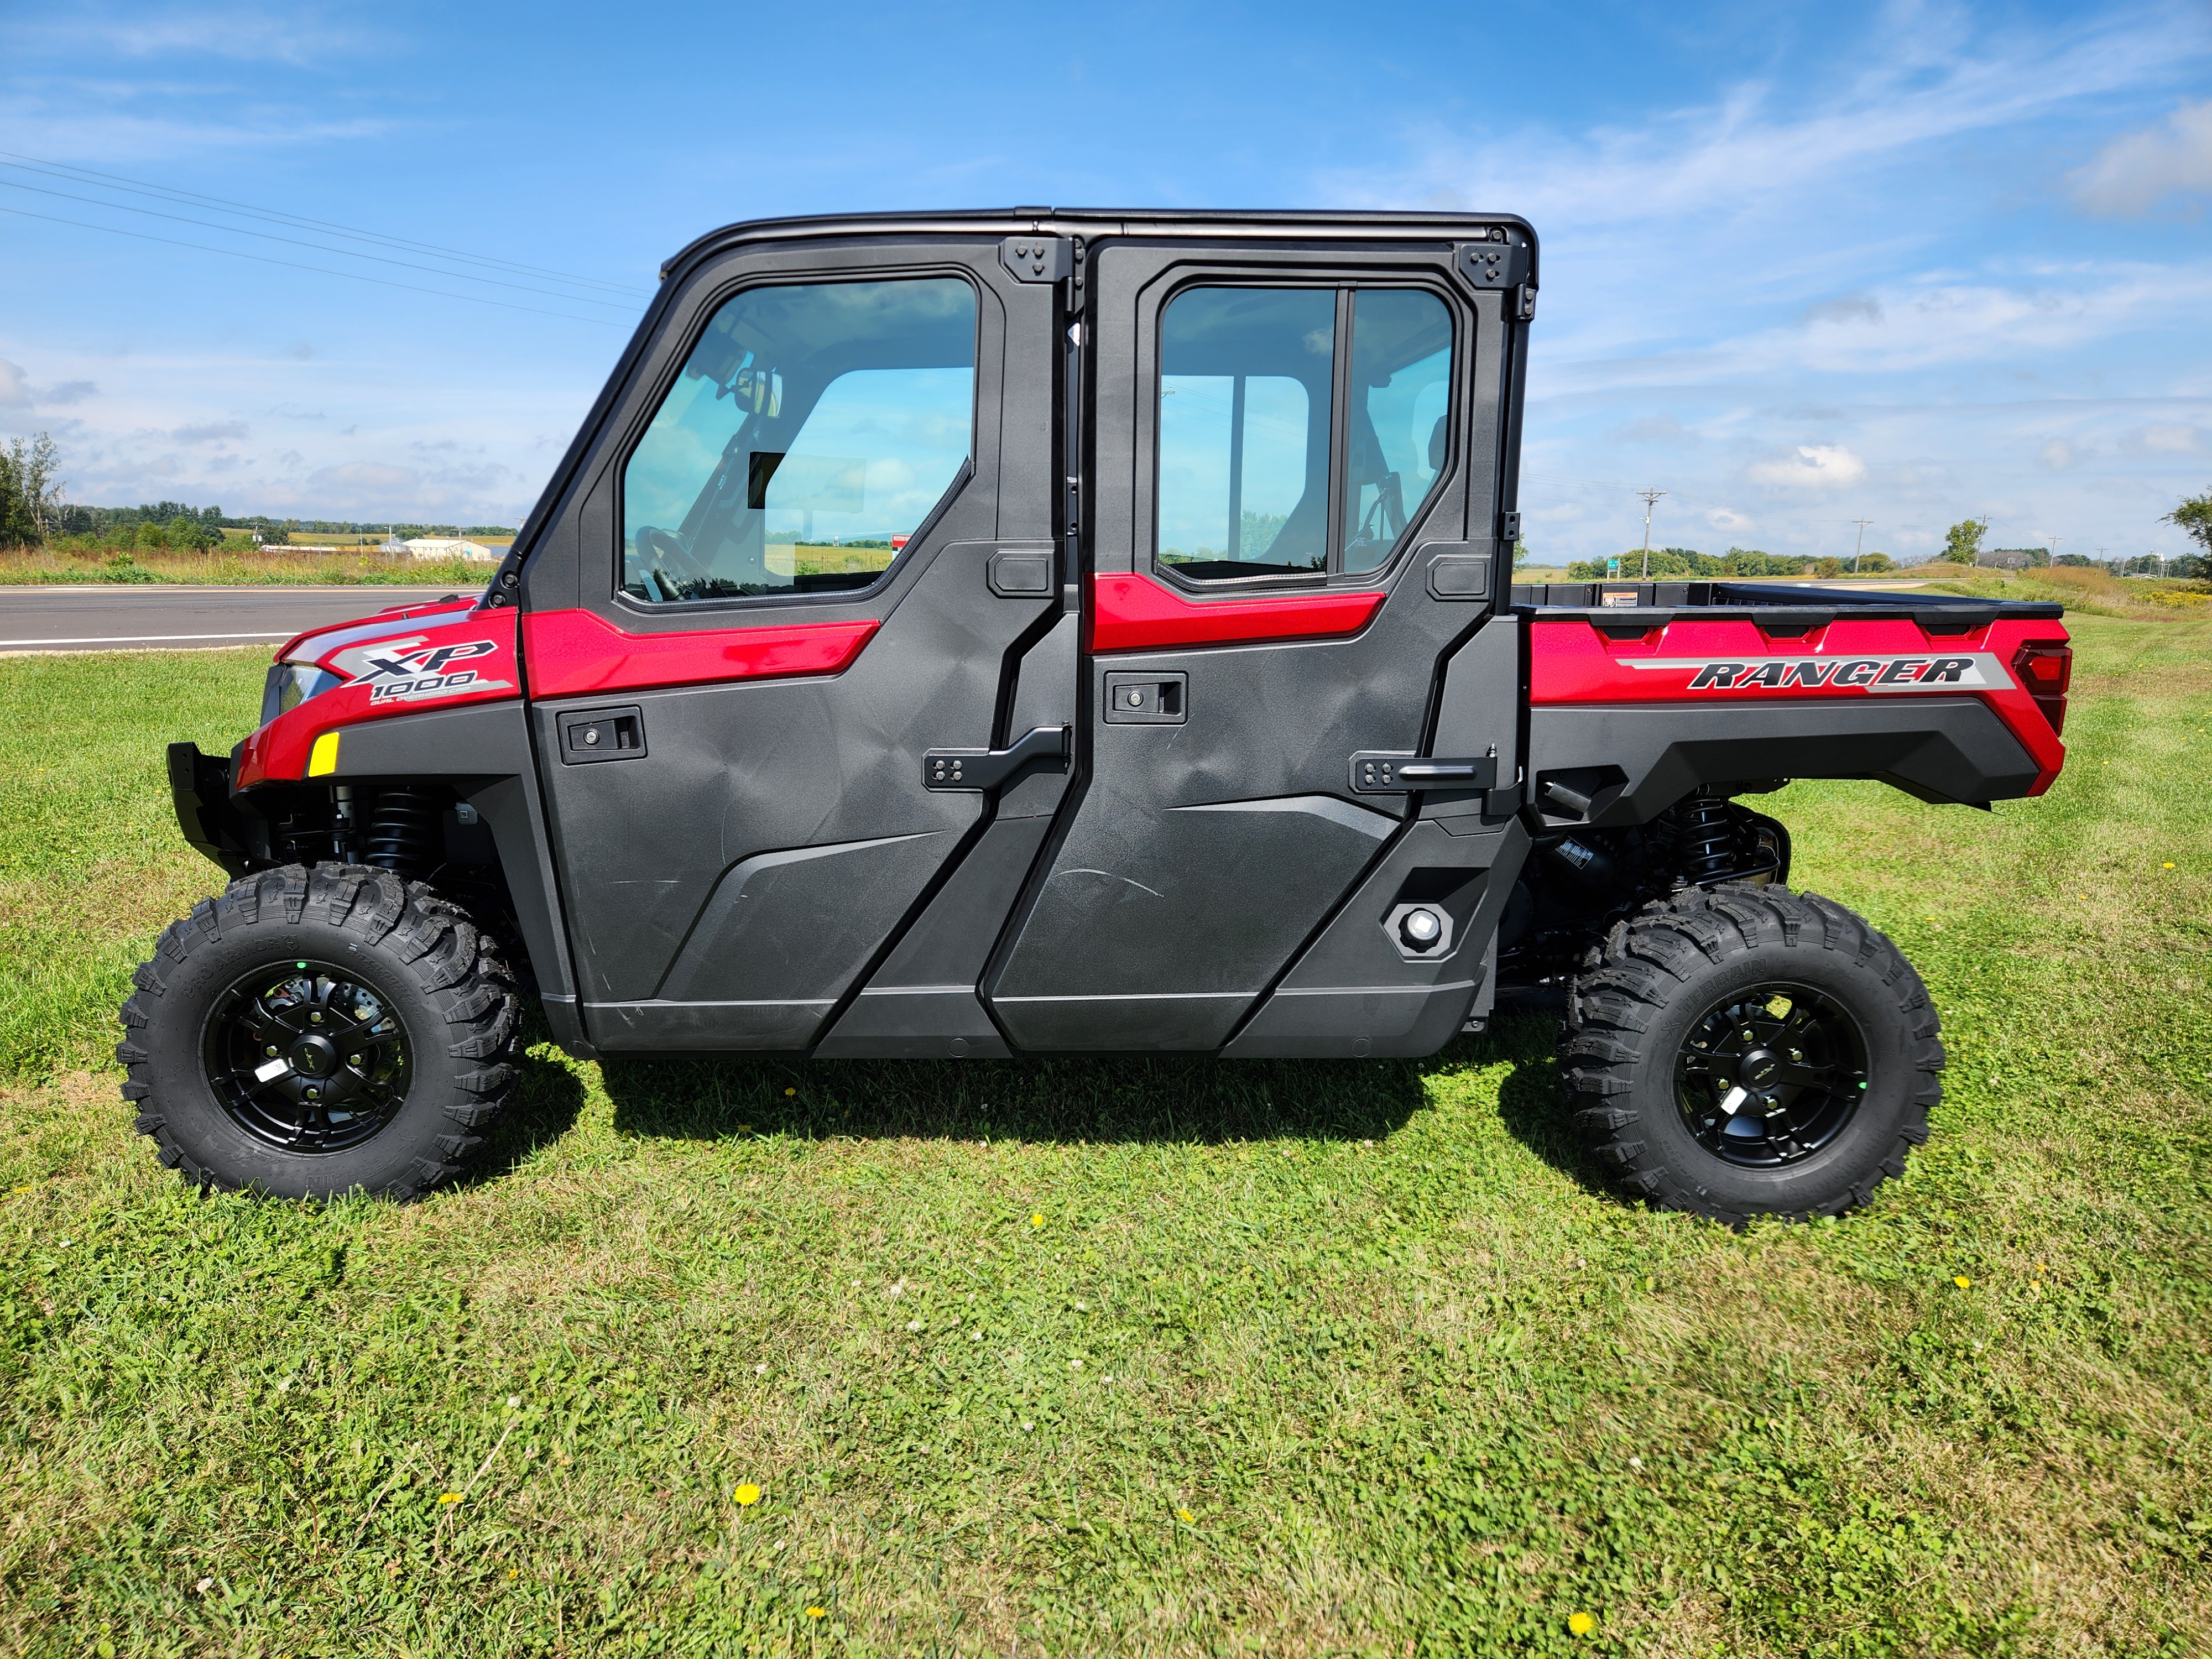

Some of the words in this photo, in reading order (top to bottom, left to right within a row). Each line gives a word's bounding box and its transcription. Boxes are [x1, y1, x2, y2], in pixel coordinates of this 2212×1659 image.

[340, 639, 499, 688] XP
[1687, 657, 1976, 690] RANGER
[369, 670, 478, 701] 1000
[370, 698, 395, 706] DUAL
[396, 691, 447, 702] OVERHEAD
[212, 937, 281, 971] ARMOR
